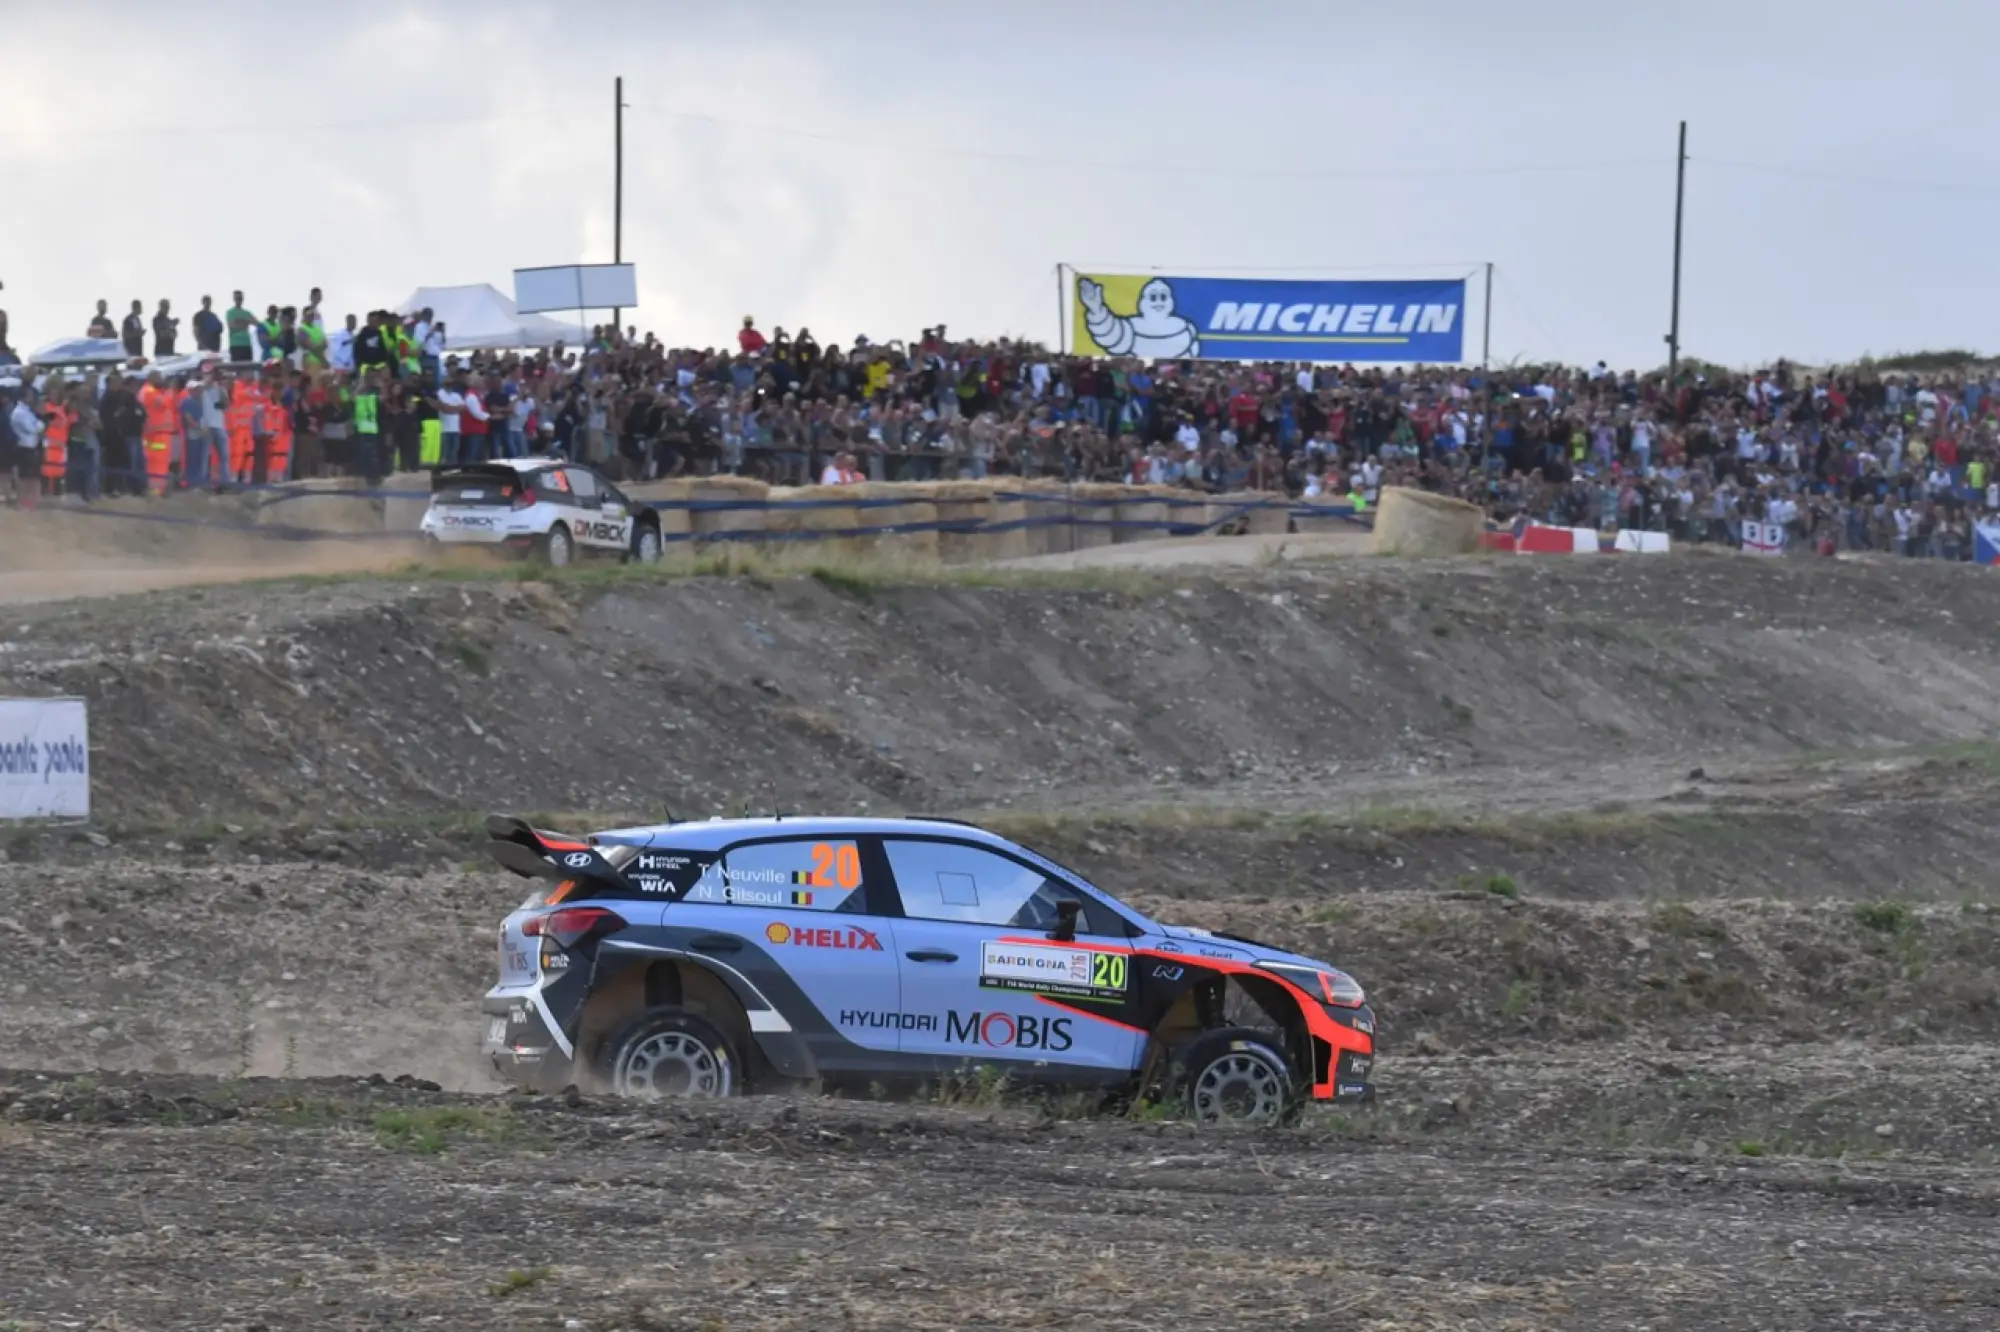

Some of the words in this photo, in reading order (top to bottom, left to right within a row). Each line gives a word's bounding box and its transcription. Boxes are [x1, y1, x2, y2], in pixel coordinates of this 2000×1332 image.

[1208, 302, 1458, 333] MICHELIN
[717, 865, 786, 884] Neuville
[811, 842, 860, 891] 20
[722, 886, 783, 904] Gilsoul
[793, 924, 884, 951] HELIX
[987, 954, 1066, 971] SARDEGNA
[1093, 953, 1125, 988] 20
[840, 1010, 938, 1031] HYUNDAI
[945, 1010, 1073, 1051] MOBIS
